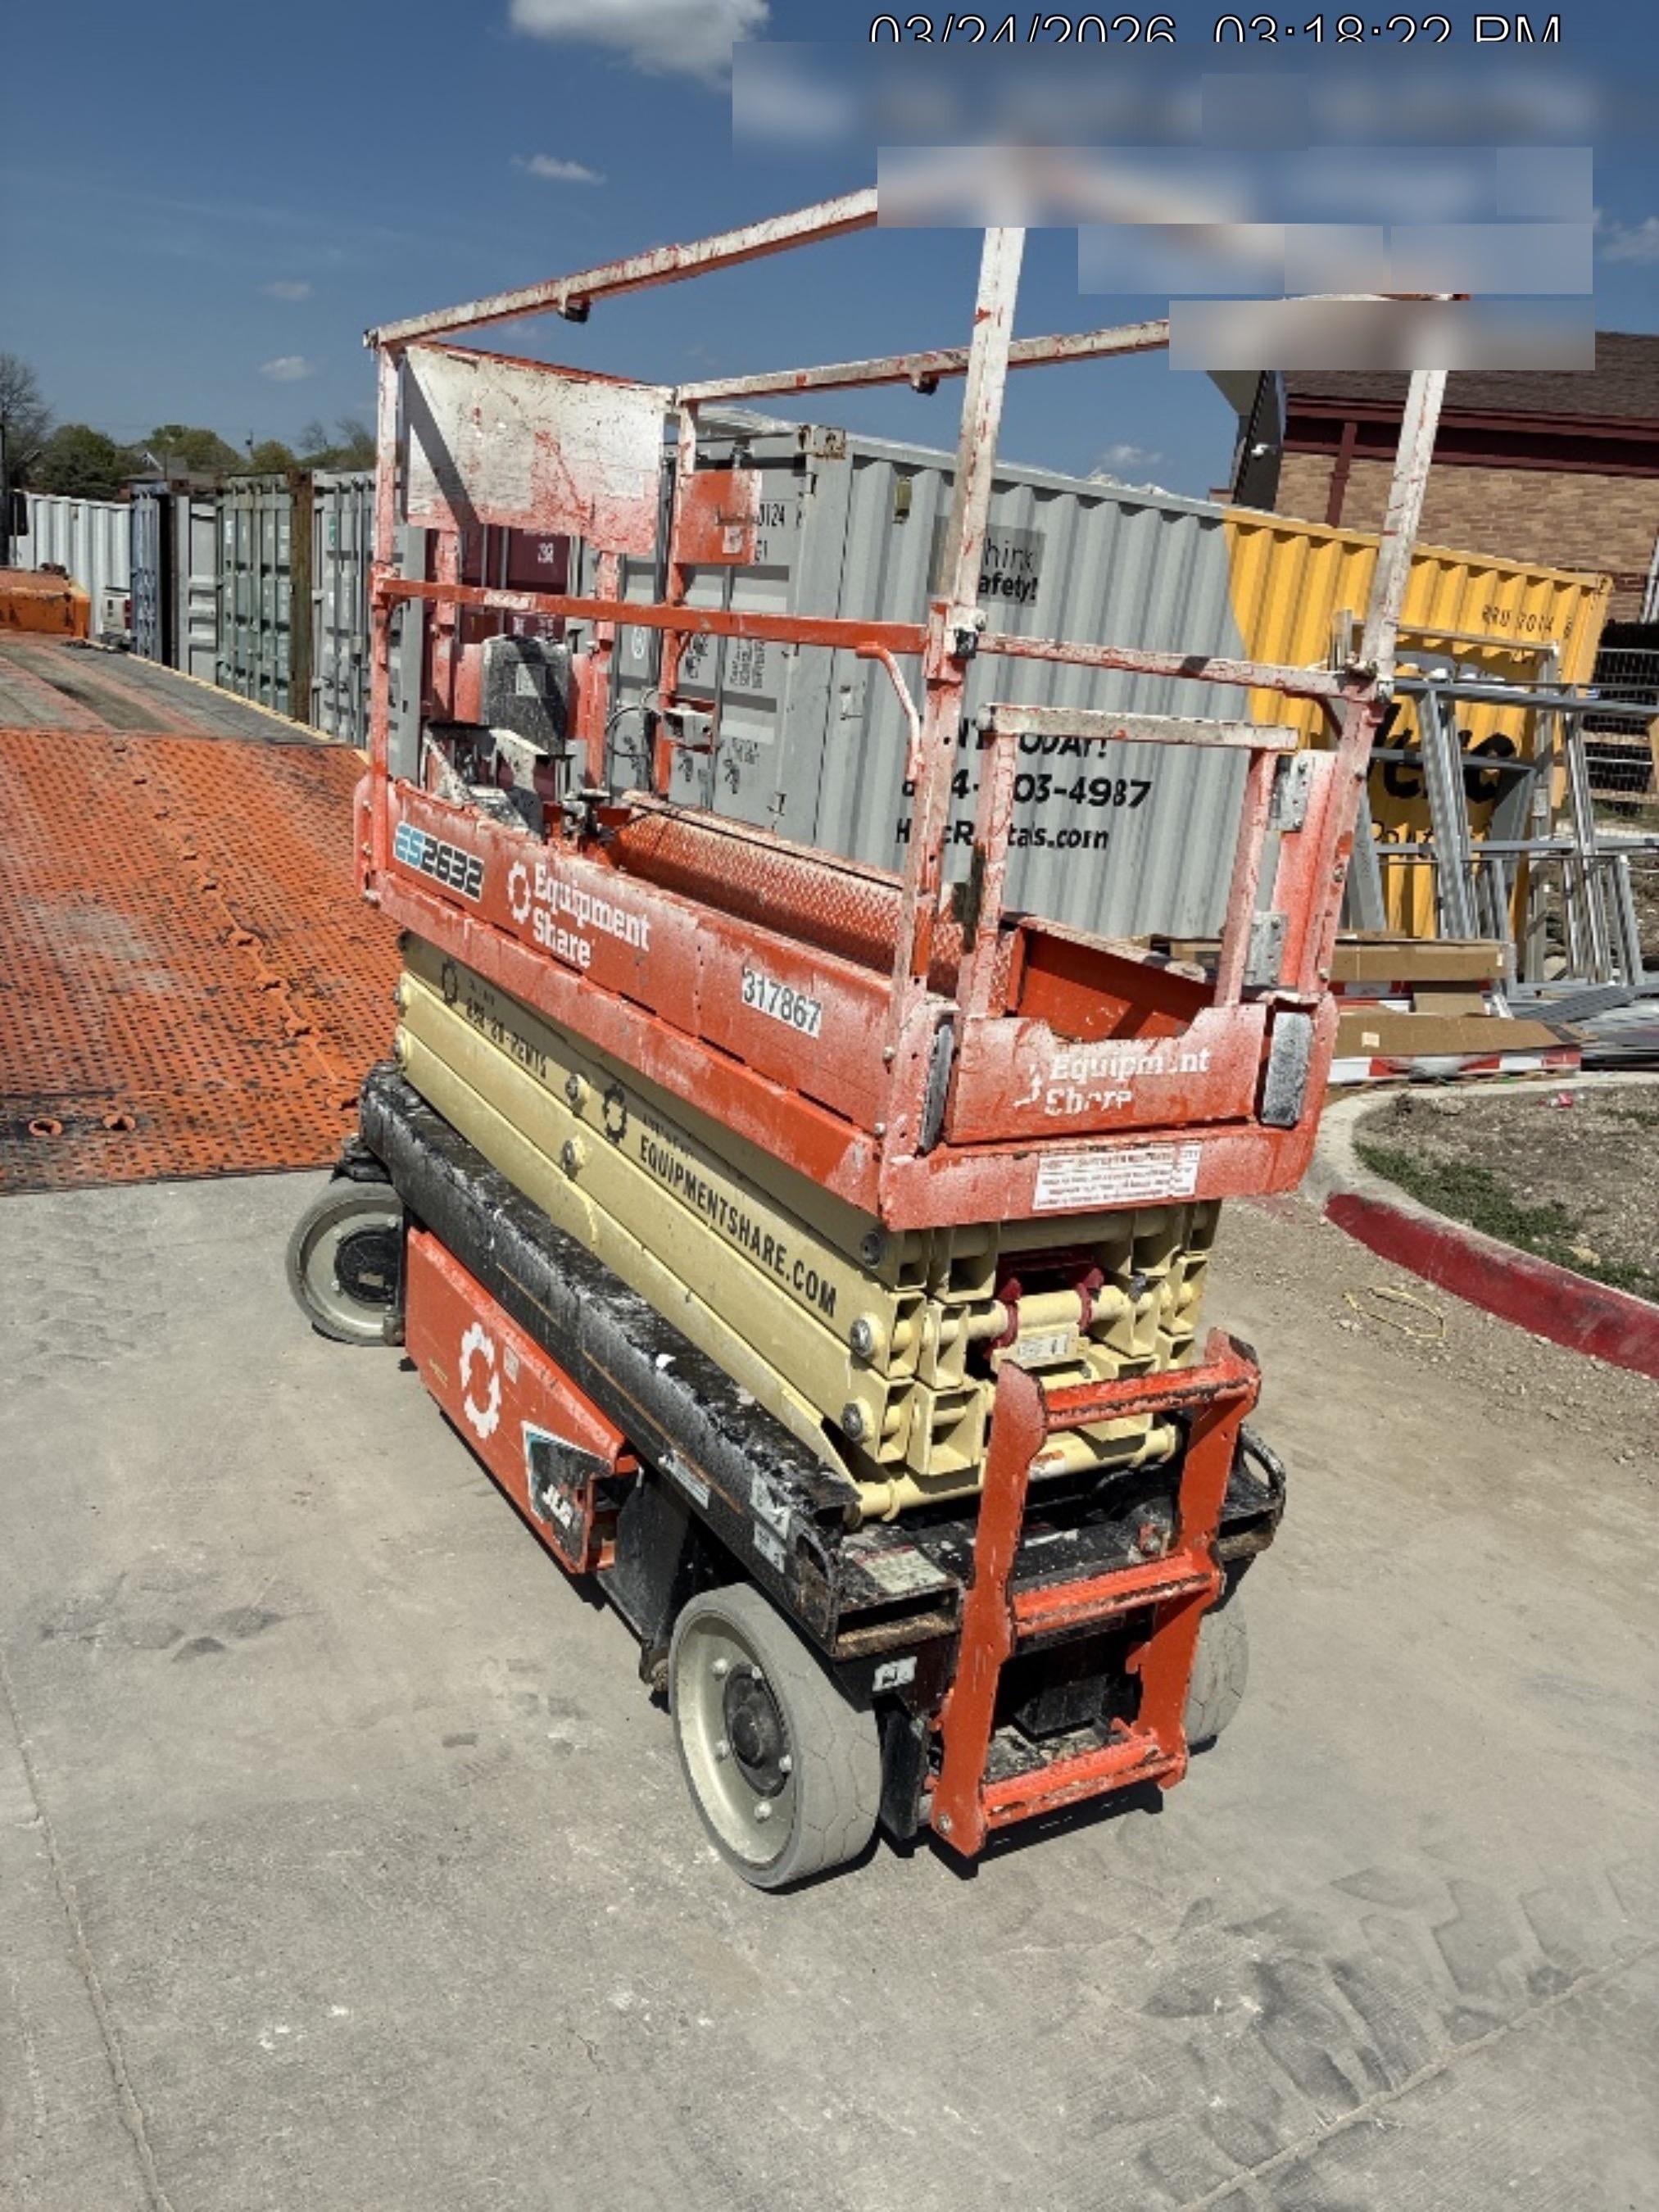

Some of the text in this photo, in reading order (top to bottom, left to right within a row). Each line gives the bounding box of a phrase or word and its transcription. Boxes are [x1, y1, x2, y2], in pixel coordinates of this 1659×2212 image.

[985, 537, 1033, 573] hink
[978, 572, 1038, 603] afety!
[533, 861, 650, 951] Equipment
[533, 908, 592, 969] Share
[743, 970, 821, 1031] 317867
[640, 1134, 836, 1317] EQUIPMENTSHARE.COM
